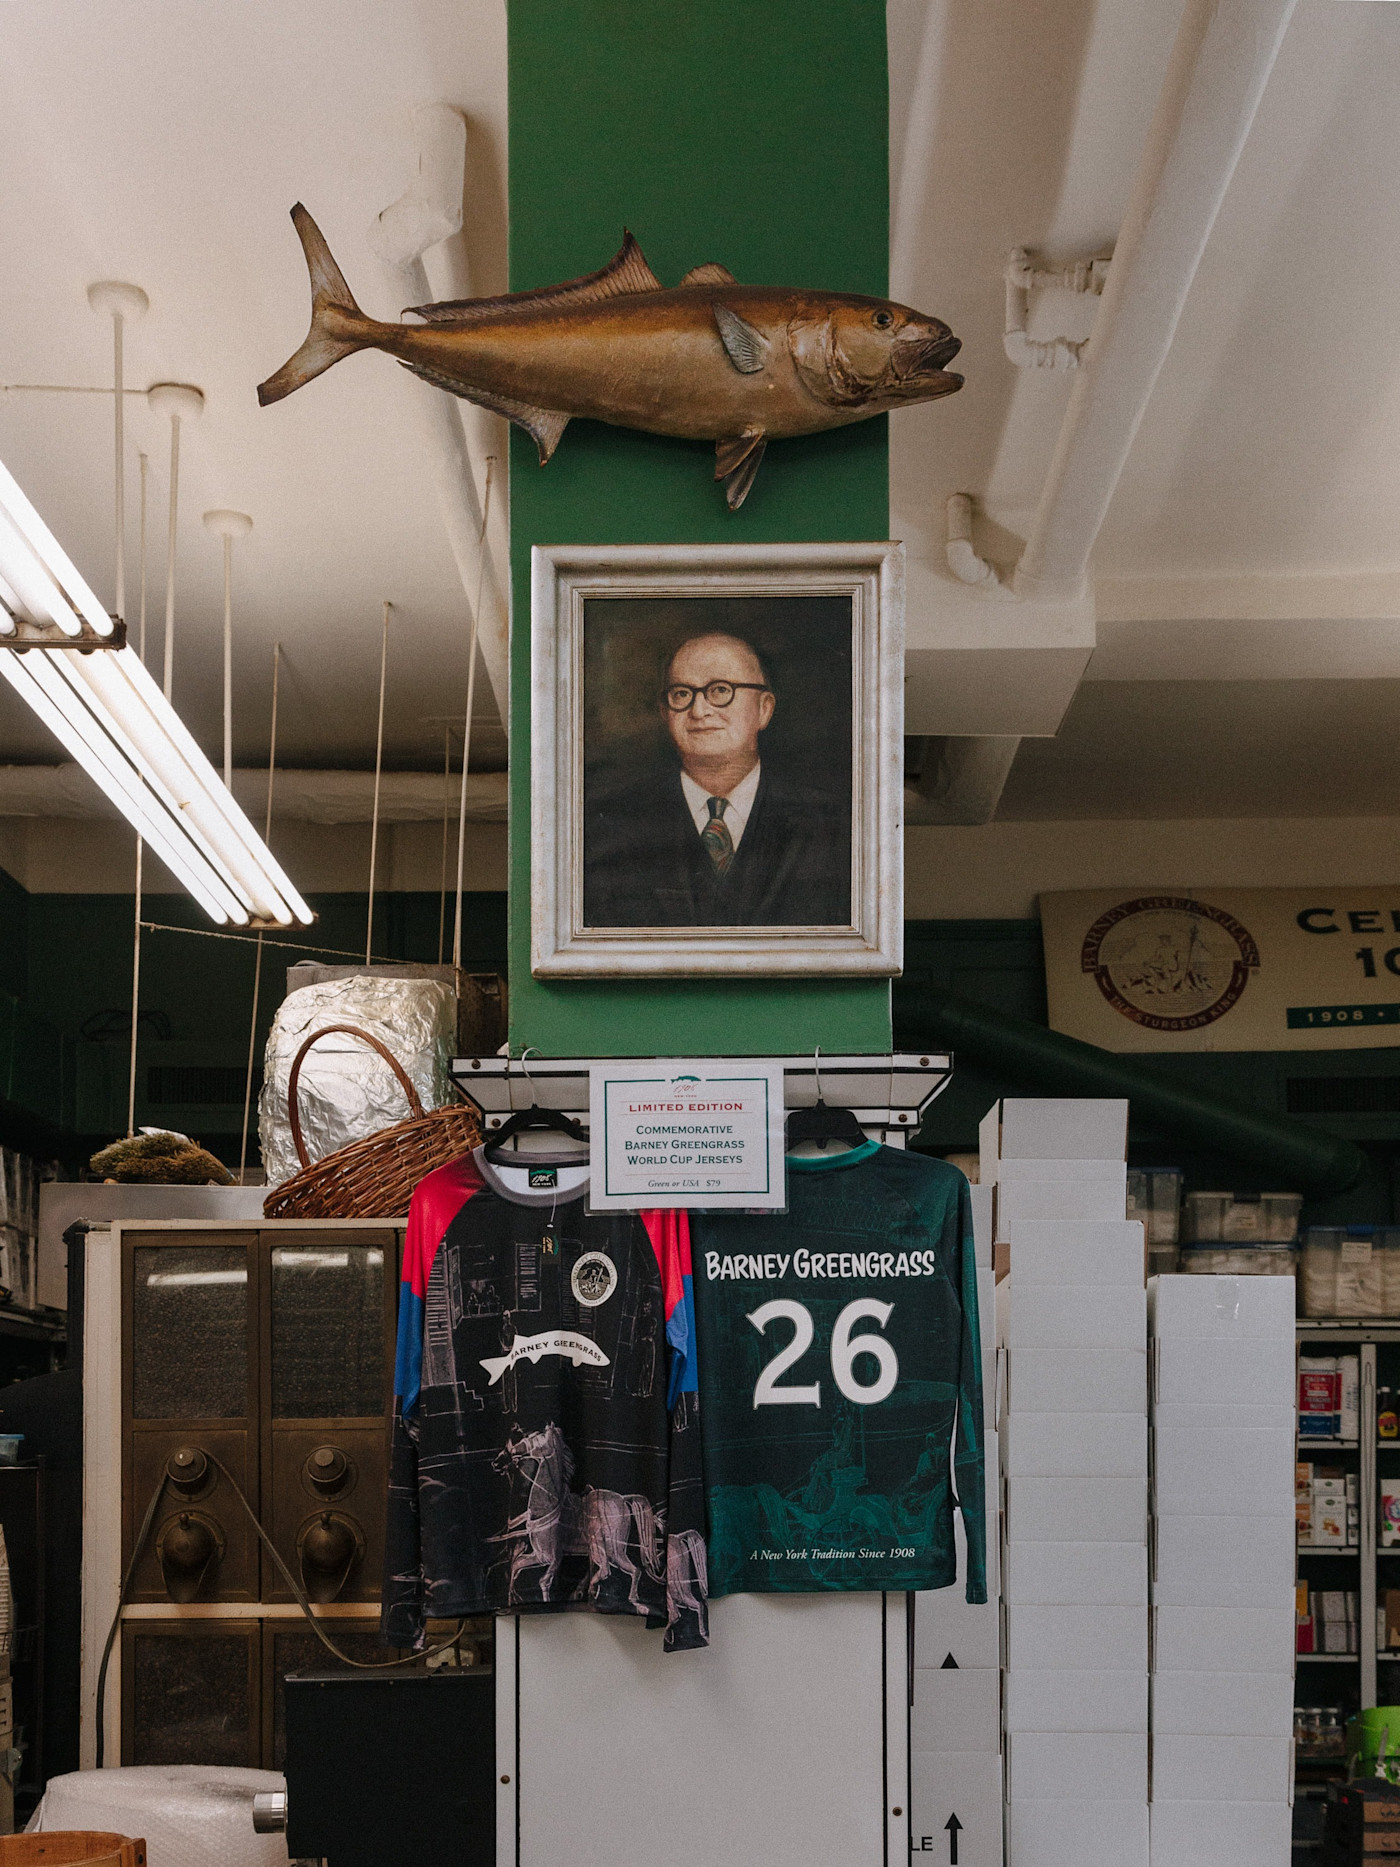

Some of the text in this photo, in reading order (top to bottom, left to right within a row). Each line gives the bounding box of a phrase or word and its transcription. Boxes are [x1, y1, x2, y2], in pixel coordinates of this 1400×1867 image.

[1210, 993, 1238, 1019] KING
[1306, 1010, 1364, 1023] 1908
[629, 1103, 743, 1112] LIMITED EDITION
[636, 1125, 733, 1135] COMMEMORATIVE
[625, 1140, 745, 1150] BARNEY GREENGRASS
[627, 1155, 743, 1165] WORLD CUP JERSEYS
[648, 1180, 670, 1188] Green
[706, 1180, 721, 1188] $79
[705, 1248, 935, 1281] BARNEY GREENGRASS
[745, 1297, 900, 1410] 26
[750, 1548, 916, 1560] A New York Tradition Since 1908
